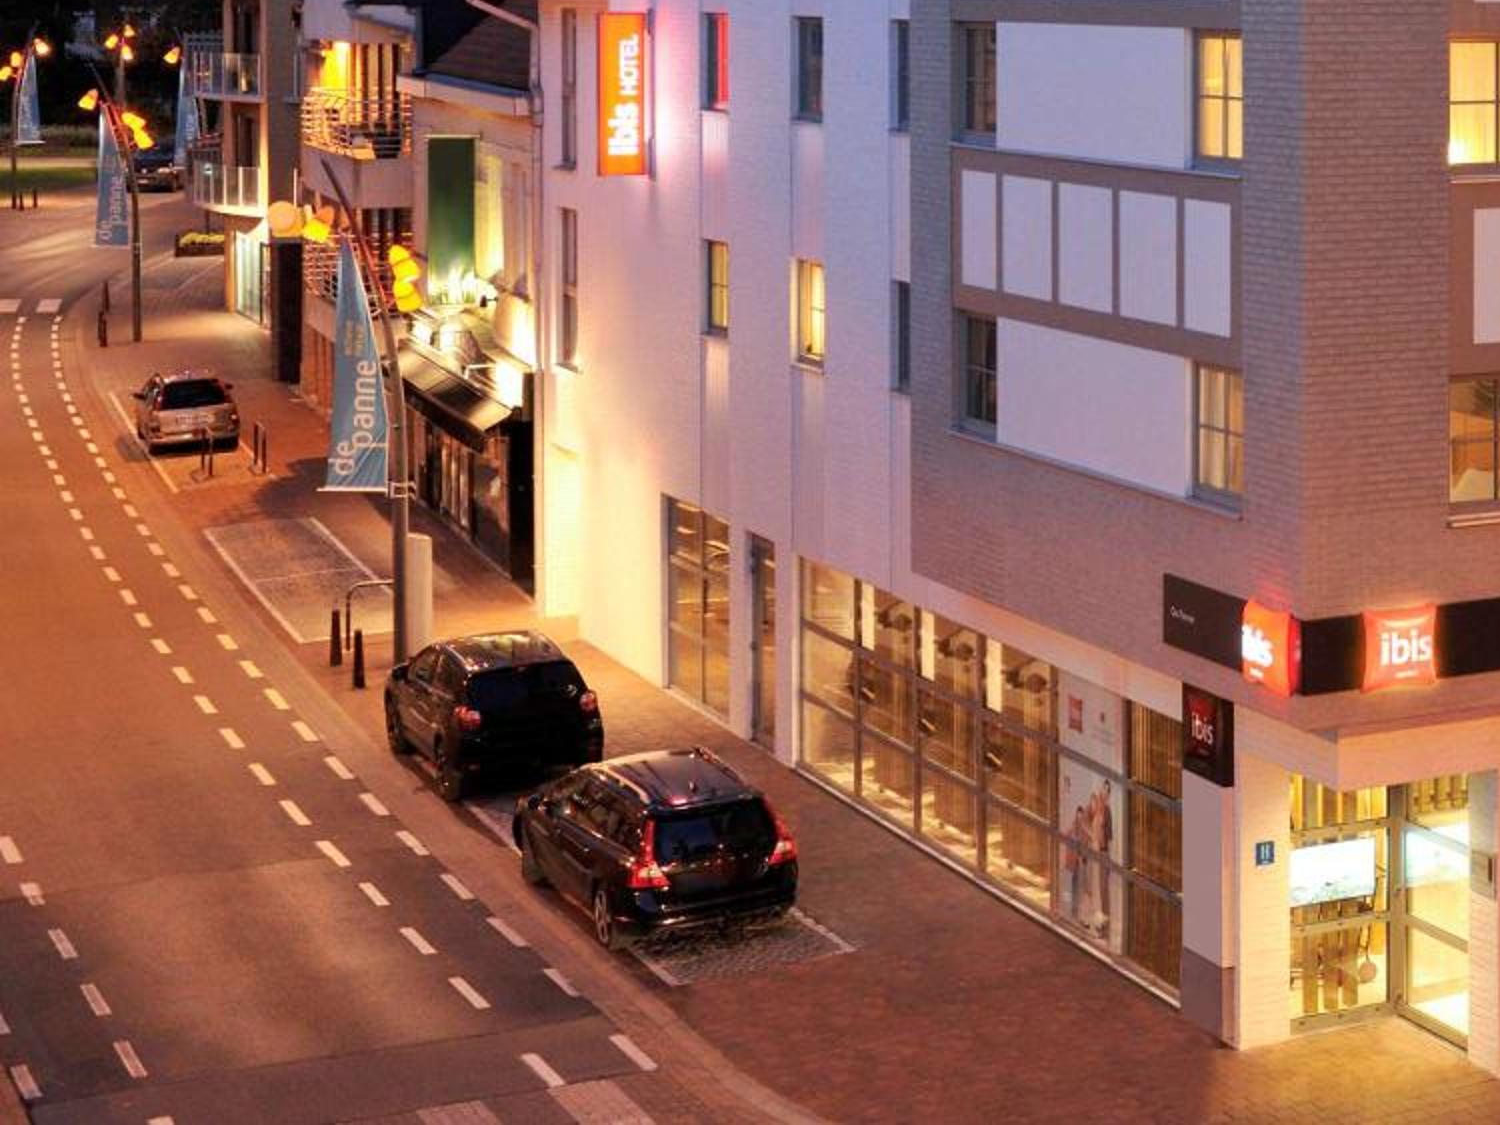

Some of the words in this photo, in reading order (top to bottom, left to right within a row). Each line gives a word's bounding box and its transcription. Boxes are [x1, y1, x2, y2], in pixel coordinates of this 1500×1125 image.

[351, 359, 386, 449] panne
[328, 440, 356, 476] de
[1380, 629, 1433, 667] ibis
[1191, 711, 1213, 745] ibis
